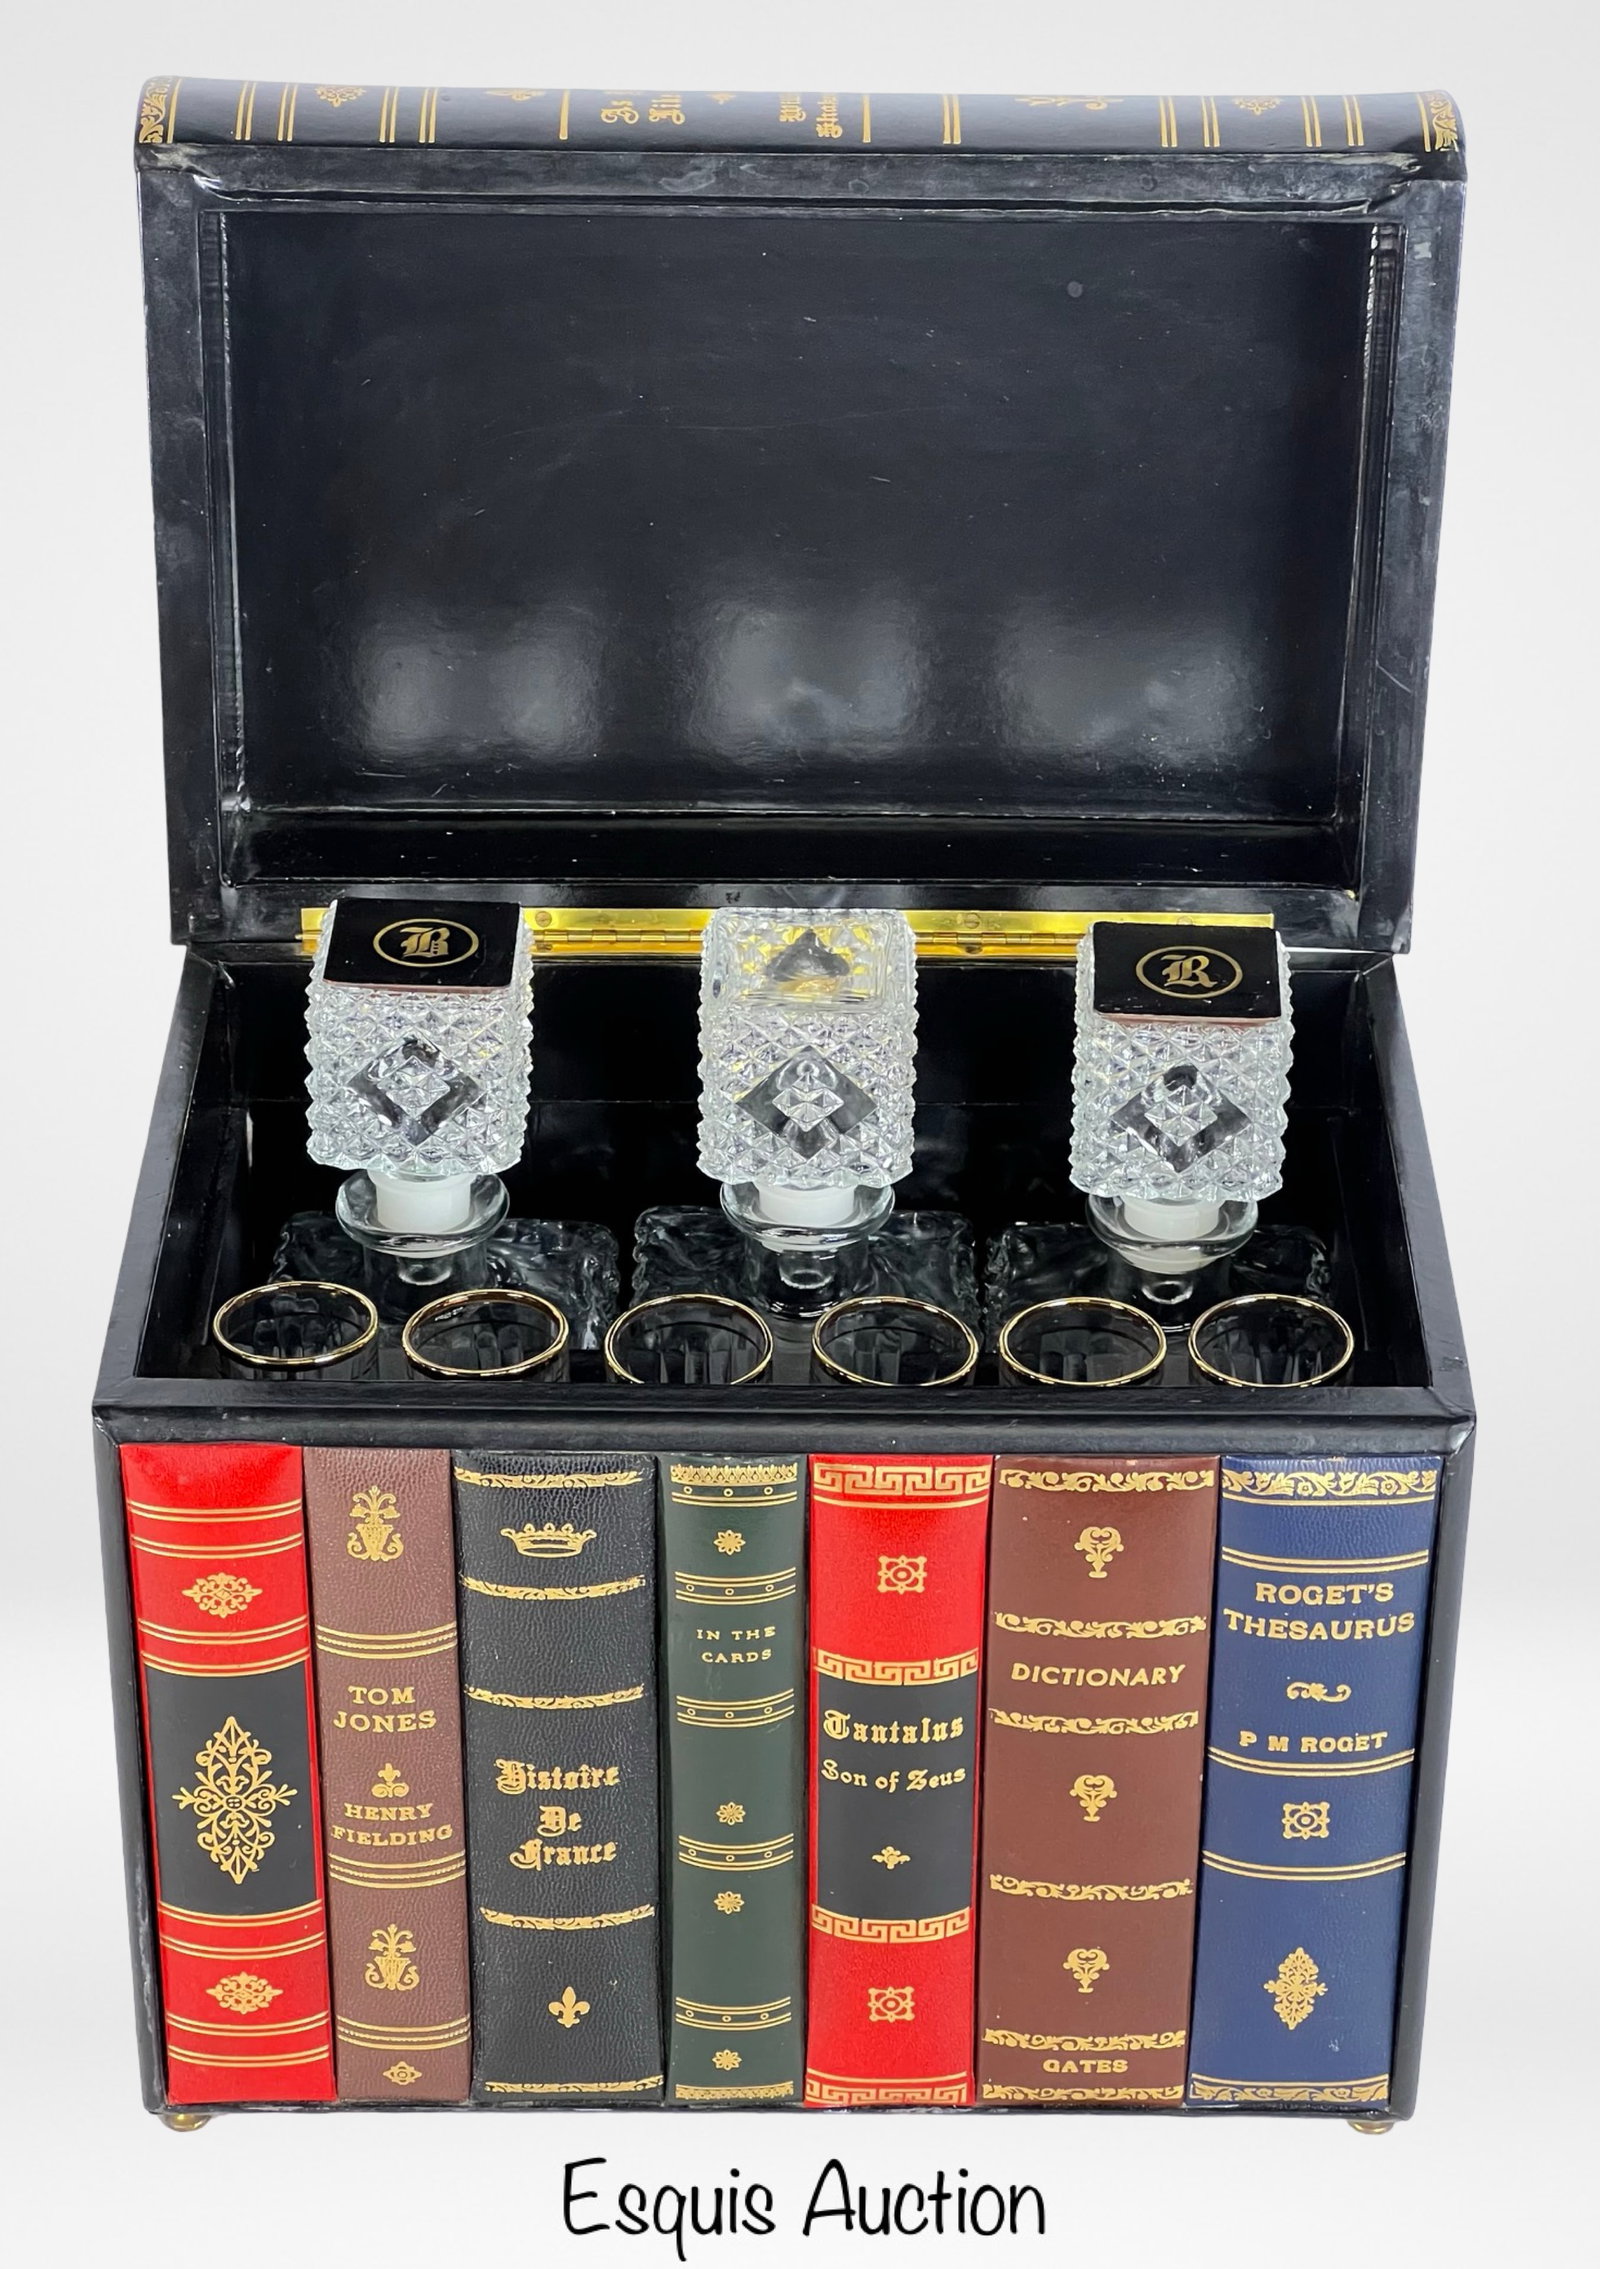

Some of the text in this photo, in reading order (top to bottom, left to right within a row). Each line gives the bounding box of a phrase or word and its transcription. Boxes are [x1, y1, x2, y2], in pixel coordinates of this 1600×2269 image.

[1255, 1582, 1394, 1606] ROGET'S
[696, 1625, 776, 1641] IN THE
[1223, 1608, 1415, 1640] THESAURUS
[701, 1648, 772, 1664] CARDS
[1011, 1662, 1186, 1687] DICTIONARY
[347, 1685, 416, 1705] TOM
[333, 1709, 437, 1733] JONES
[823, 1709, 964, 1744] Tantalus
[1239, 1731, 1388, 1753] P M ROGET
[821, 1759, 966, 1793] Son of Zeus
[343, 1803, 433, 1821] HENRY
[537, 1805, 582, 1837] De
[331, 1824, 453, 1846] FIELDING
[509, 1839, 618, 1871] France
[1043, 2059, 1128, 2073] GATES
